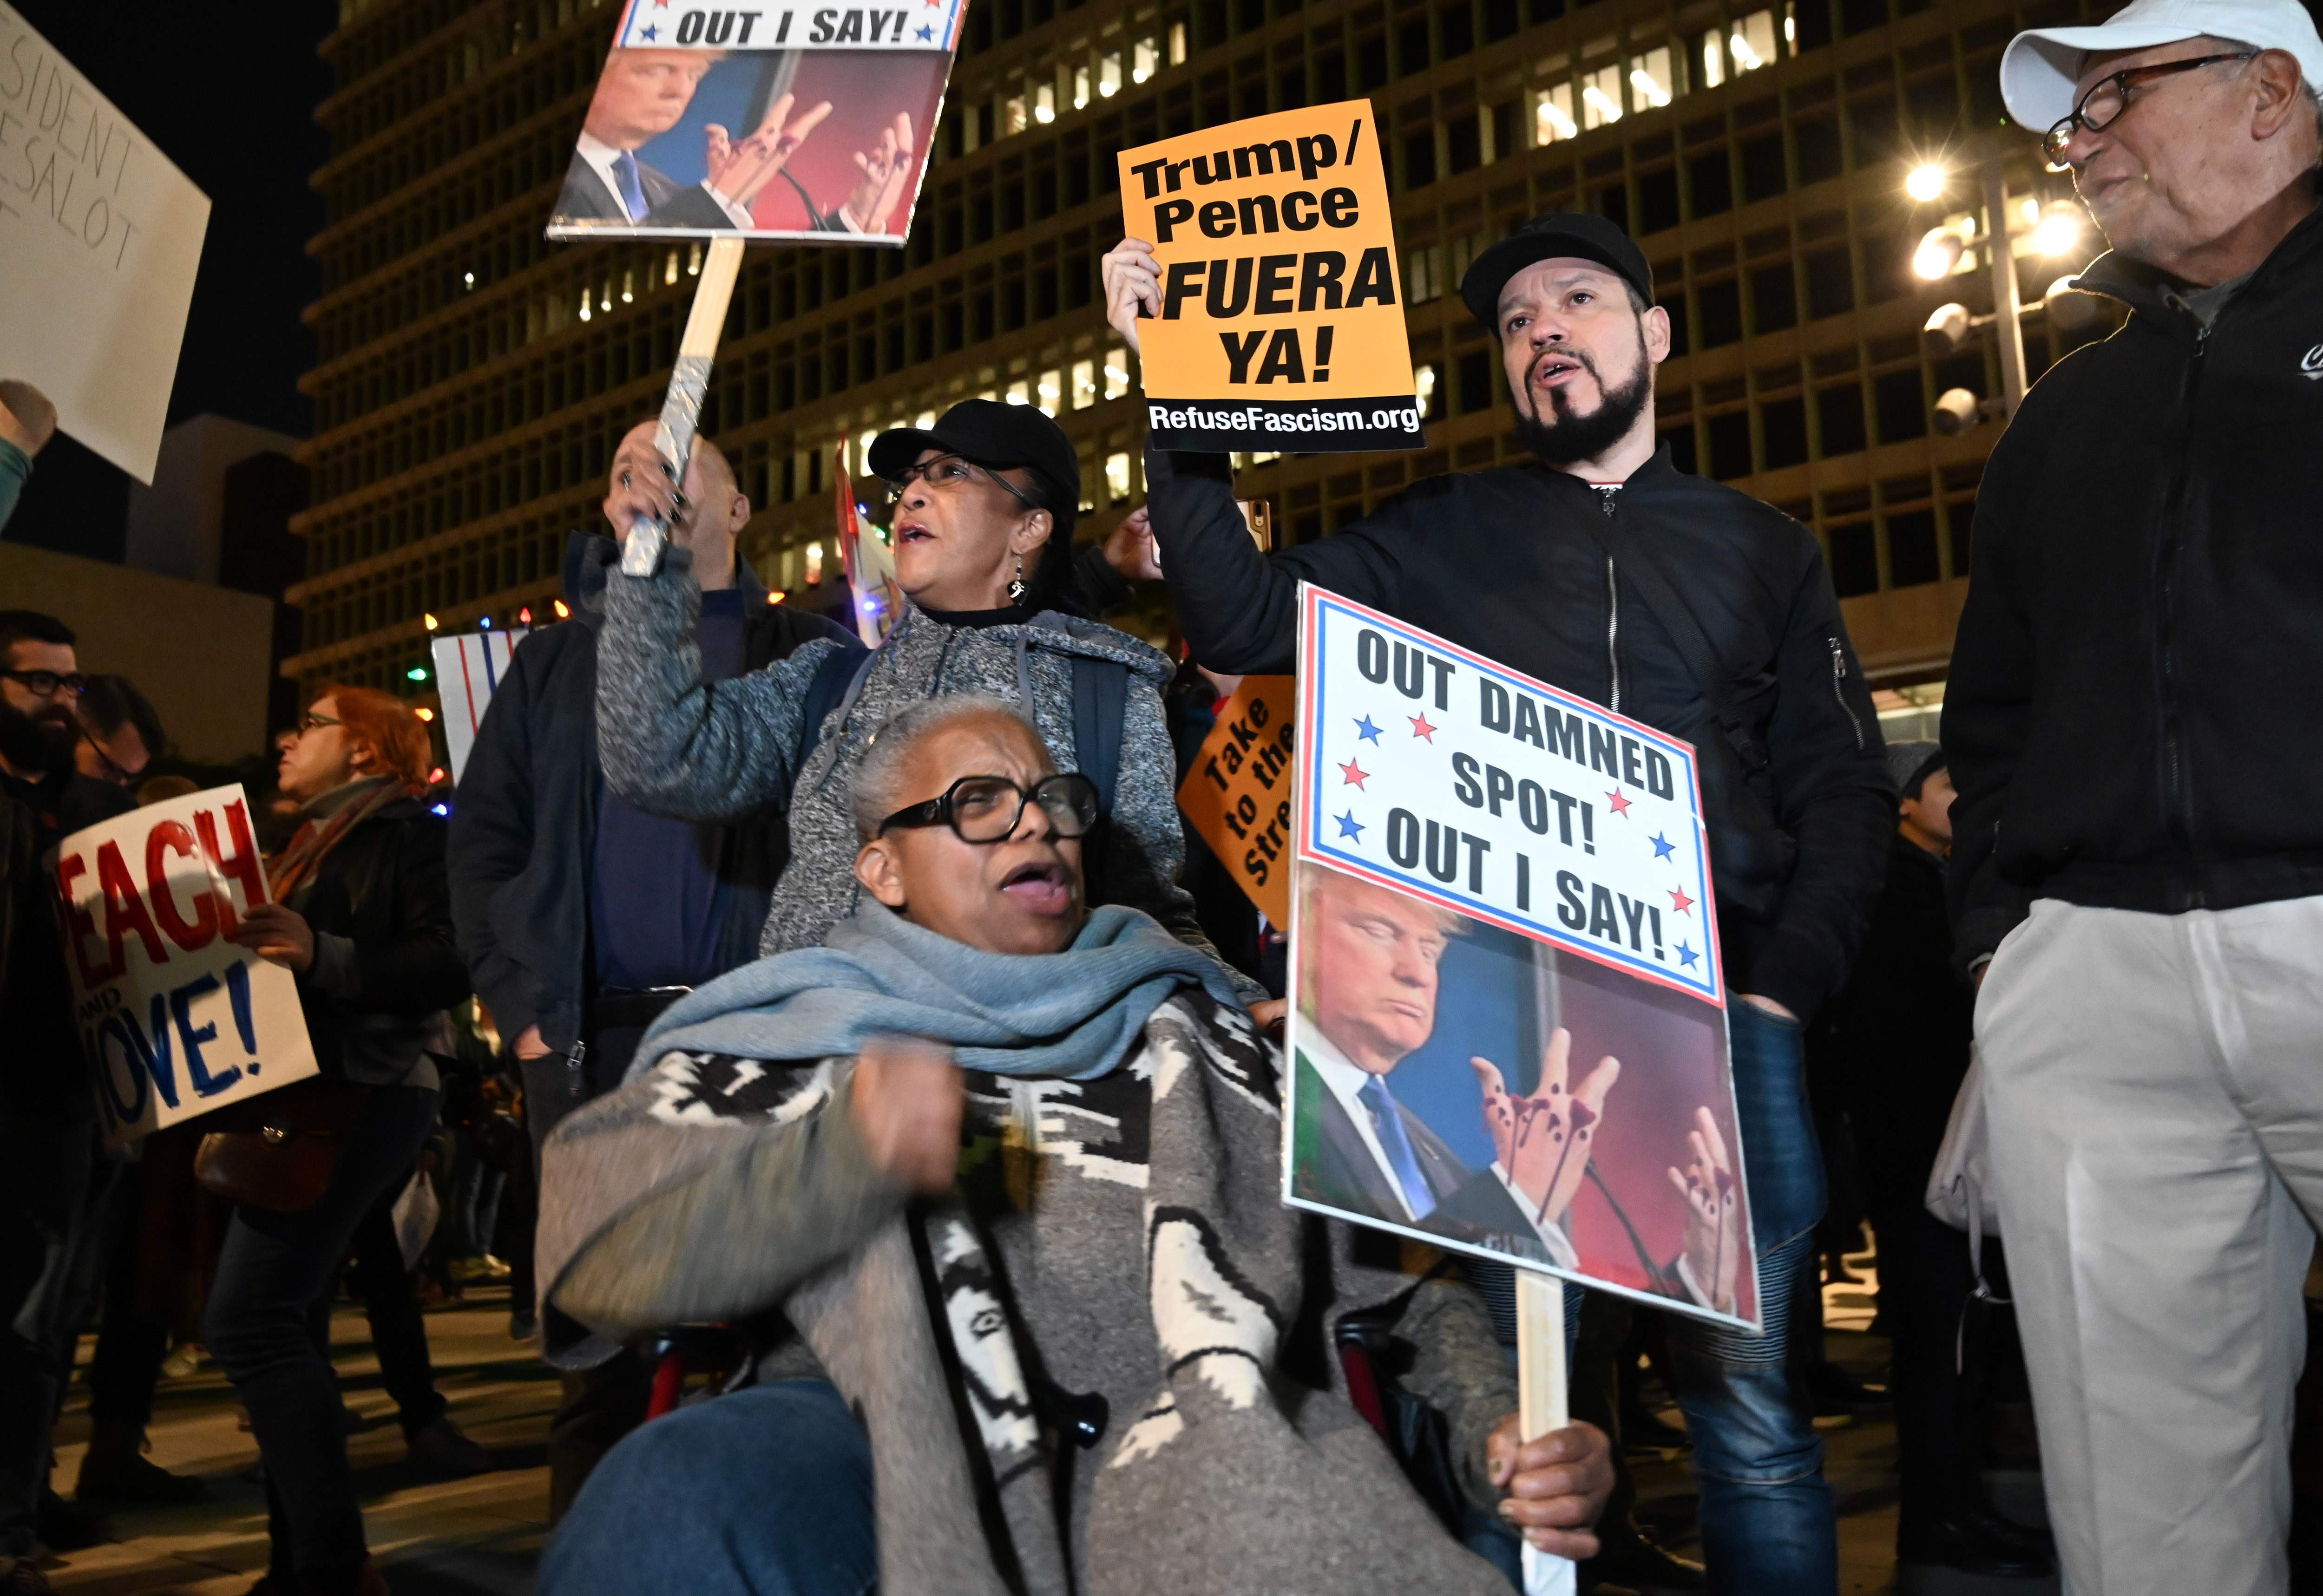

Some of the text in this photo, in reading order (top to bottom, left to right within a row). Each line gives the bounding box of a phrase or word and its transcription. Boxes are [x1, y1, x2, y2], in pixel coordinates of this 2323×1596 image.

[675, 9, 909, 44] OUT I SAY!
[0, 14, 144, 196] SIDENT
[1131, 119, 1362, 200] Trump/
[1154, 186, 1359, 243] Pence
[1219, 325, 1334, 384] YA!
[1149, 406, 1420, 433] RefuseFascism.org
[1204, 698, 1270, 791] Take
[1357, 628, 1674, 801] OUT DAMNED
[1224, 721, 1294, 841] to the
[1451, 751, 1595, 856] SPOT!
[1244, 785, 1291, 887] stre
[1386, 806, 1665, 961] OUT I SAY!
[52, 797, 273, 990] EACH
[88, 959, 261, 1132] OVE!
